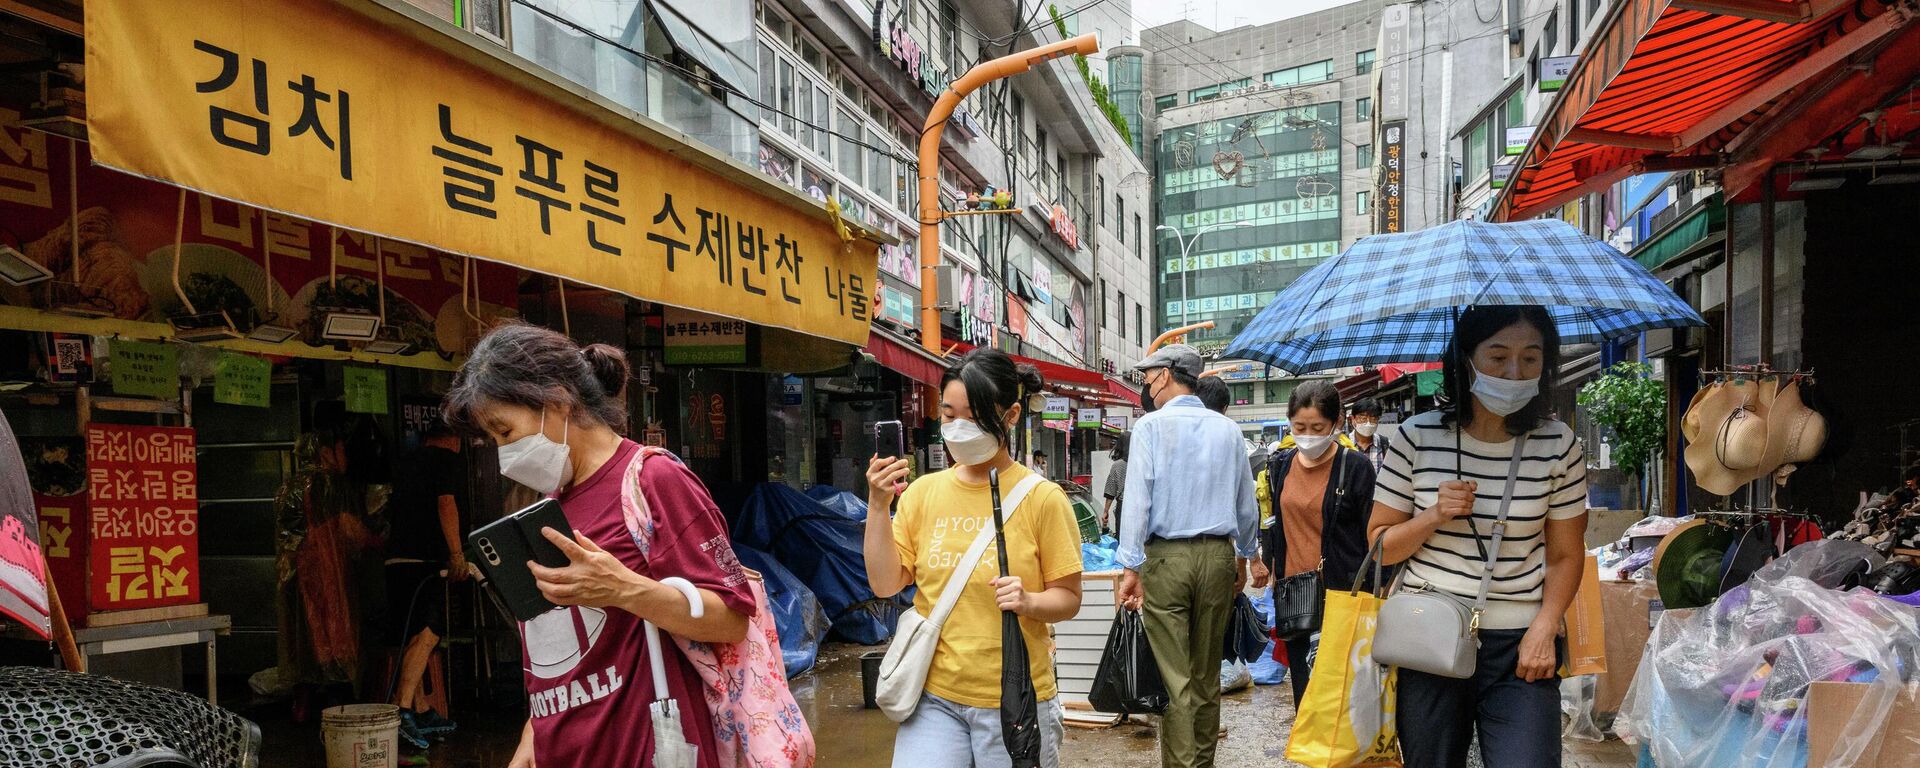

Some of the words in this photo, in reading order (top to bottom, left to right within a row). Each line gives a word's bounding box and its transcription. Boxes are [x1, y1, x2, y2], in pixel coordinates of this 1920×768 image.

[193, 39, 353, 181] 김치
[431, 103, 626, 256] 늘푸른
[646, 193, 803, 304] 수제반찬
[824, 266, 869, 322] 나물
[1387, 145, 1401, 233] 광덕안정한의원
[666, 320, 745, 337] 늘푸른수제반찬
[1170, 294, 1253, 314] 최인호치과
[89, 468, 197, 501] 명란젓갈
[928, 517, 949, 569] ONCE
[951, 516, 989, 533] YOU
[105, 544, 190, 602] 젓갈
[529, 664, 623, 719] OOTBALL
